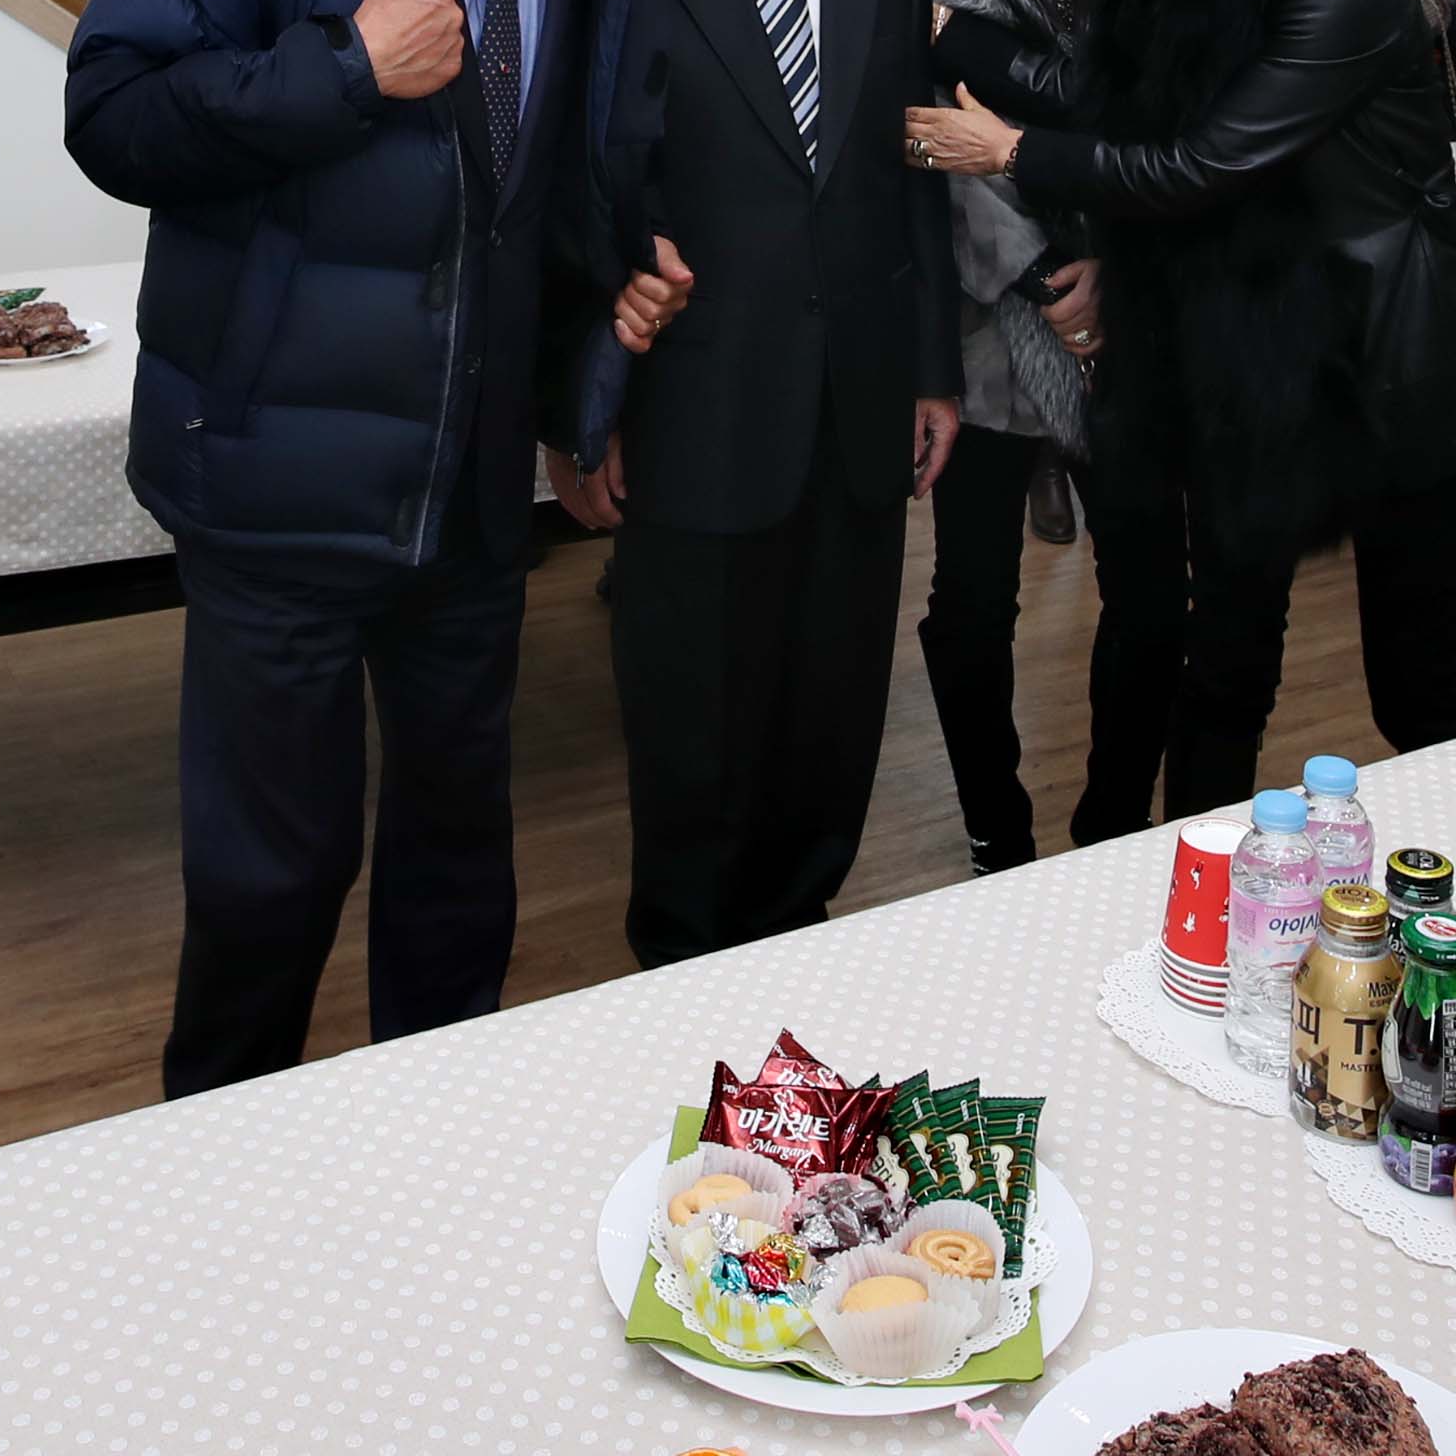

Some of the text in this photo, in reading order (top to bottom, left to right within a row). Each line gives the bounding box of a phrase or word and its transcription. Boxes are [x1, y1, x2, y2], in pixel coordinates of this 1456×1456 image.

[1268, 911, 1321, 936] 아이시
[1368, 976, 1399, 998] Max
[737, 1107, 831, 1142] 마가렛트
[745, 1138, 813, 1160] Margar
